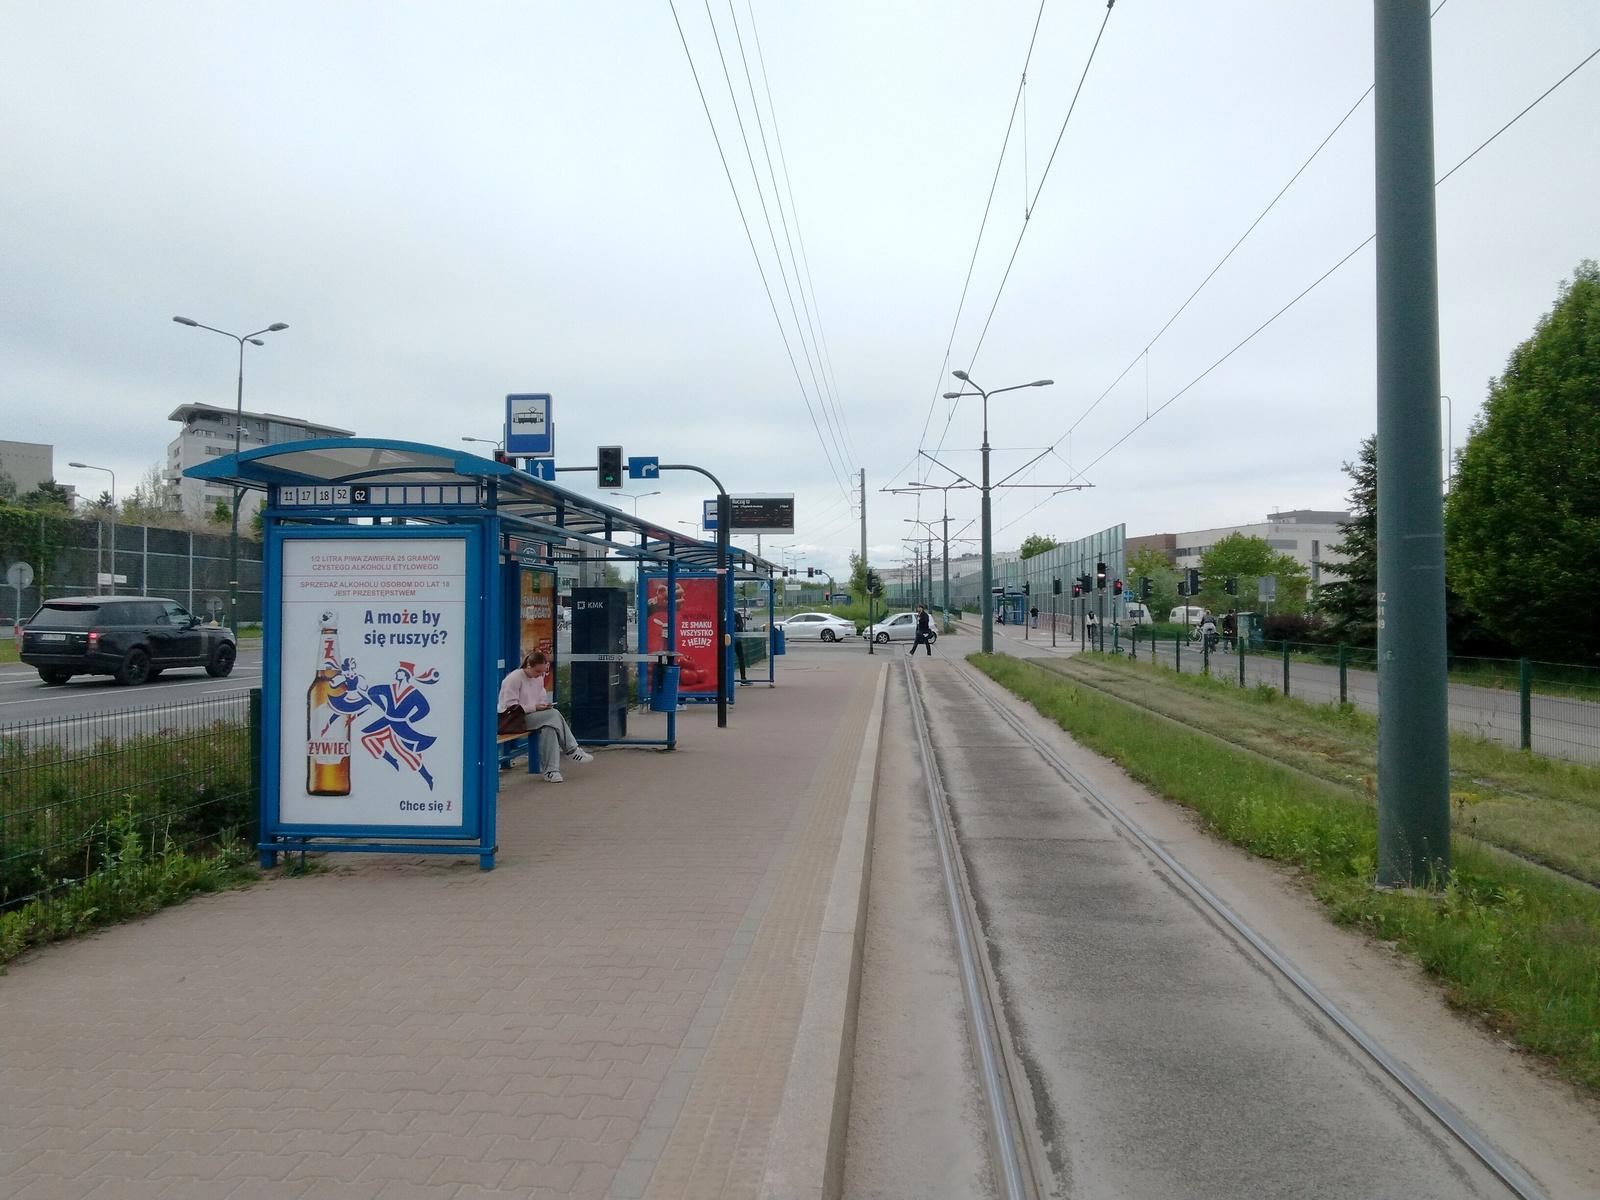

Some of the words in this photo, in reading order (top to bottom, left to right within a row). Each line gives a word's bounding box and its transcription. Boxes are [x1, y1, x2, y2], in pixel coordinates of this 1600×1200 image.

[284, 491, 293, 501] 11
[301, 491, 311, 501] 17
[319, 490, 330, 501] 18
[337, 489, 347, 500] 52
[355, 490, 366, 501] 62
[407, 554, 440, 562] GRAMÓW
[312, 563, 350, 571] CZYSTEGO
[351, 563, 391, 571] ALKOHOLU
[393, 563, 439, 571] ETYLOWEGO
[333, 589, 351, 597] JEST
[352, 589, 416, 598] PRZESTĘPSTWEM
[364, 610, 374, 624] A
[377, 609, 418, 624] może
[422, 609, 441, 628] by
[364, 630, 385, 648] się
[390, 630, 448, 648] ruszyć?
[687, 637, 712, 646] HEINZ
[400, 800, 426, 811] Chce
[428, 800, 443, 813] się
